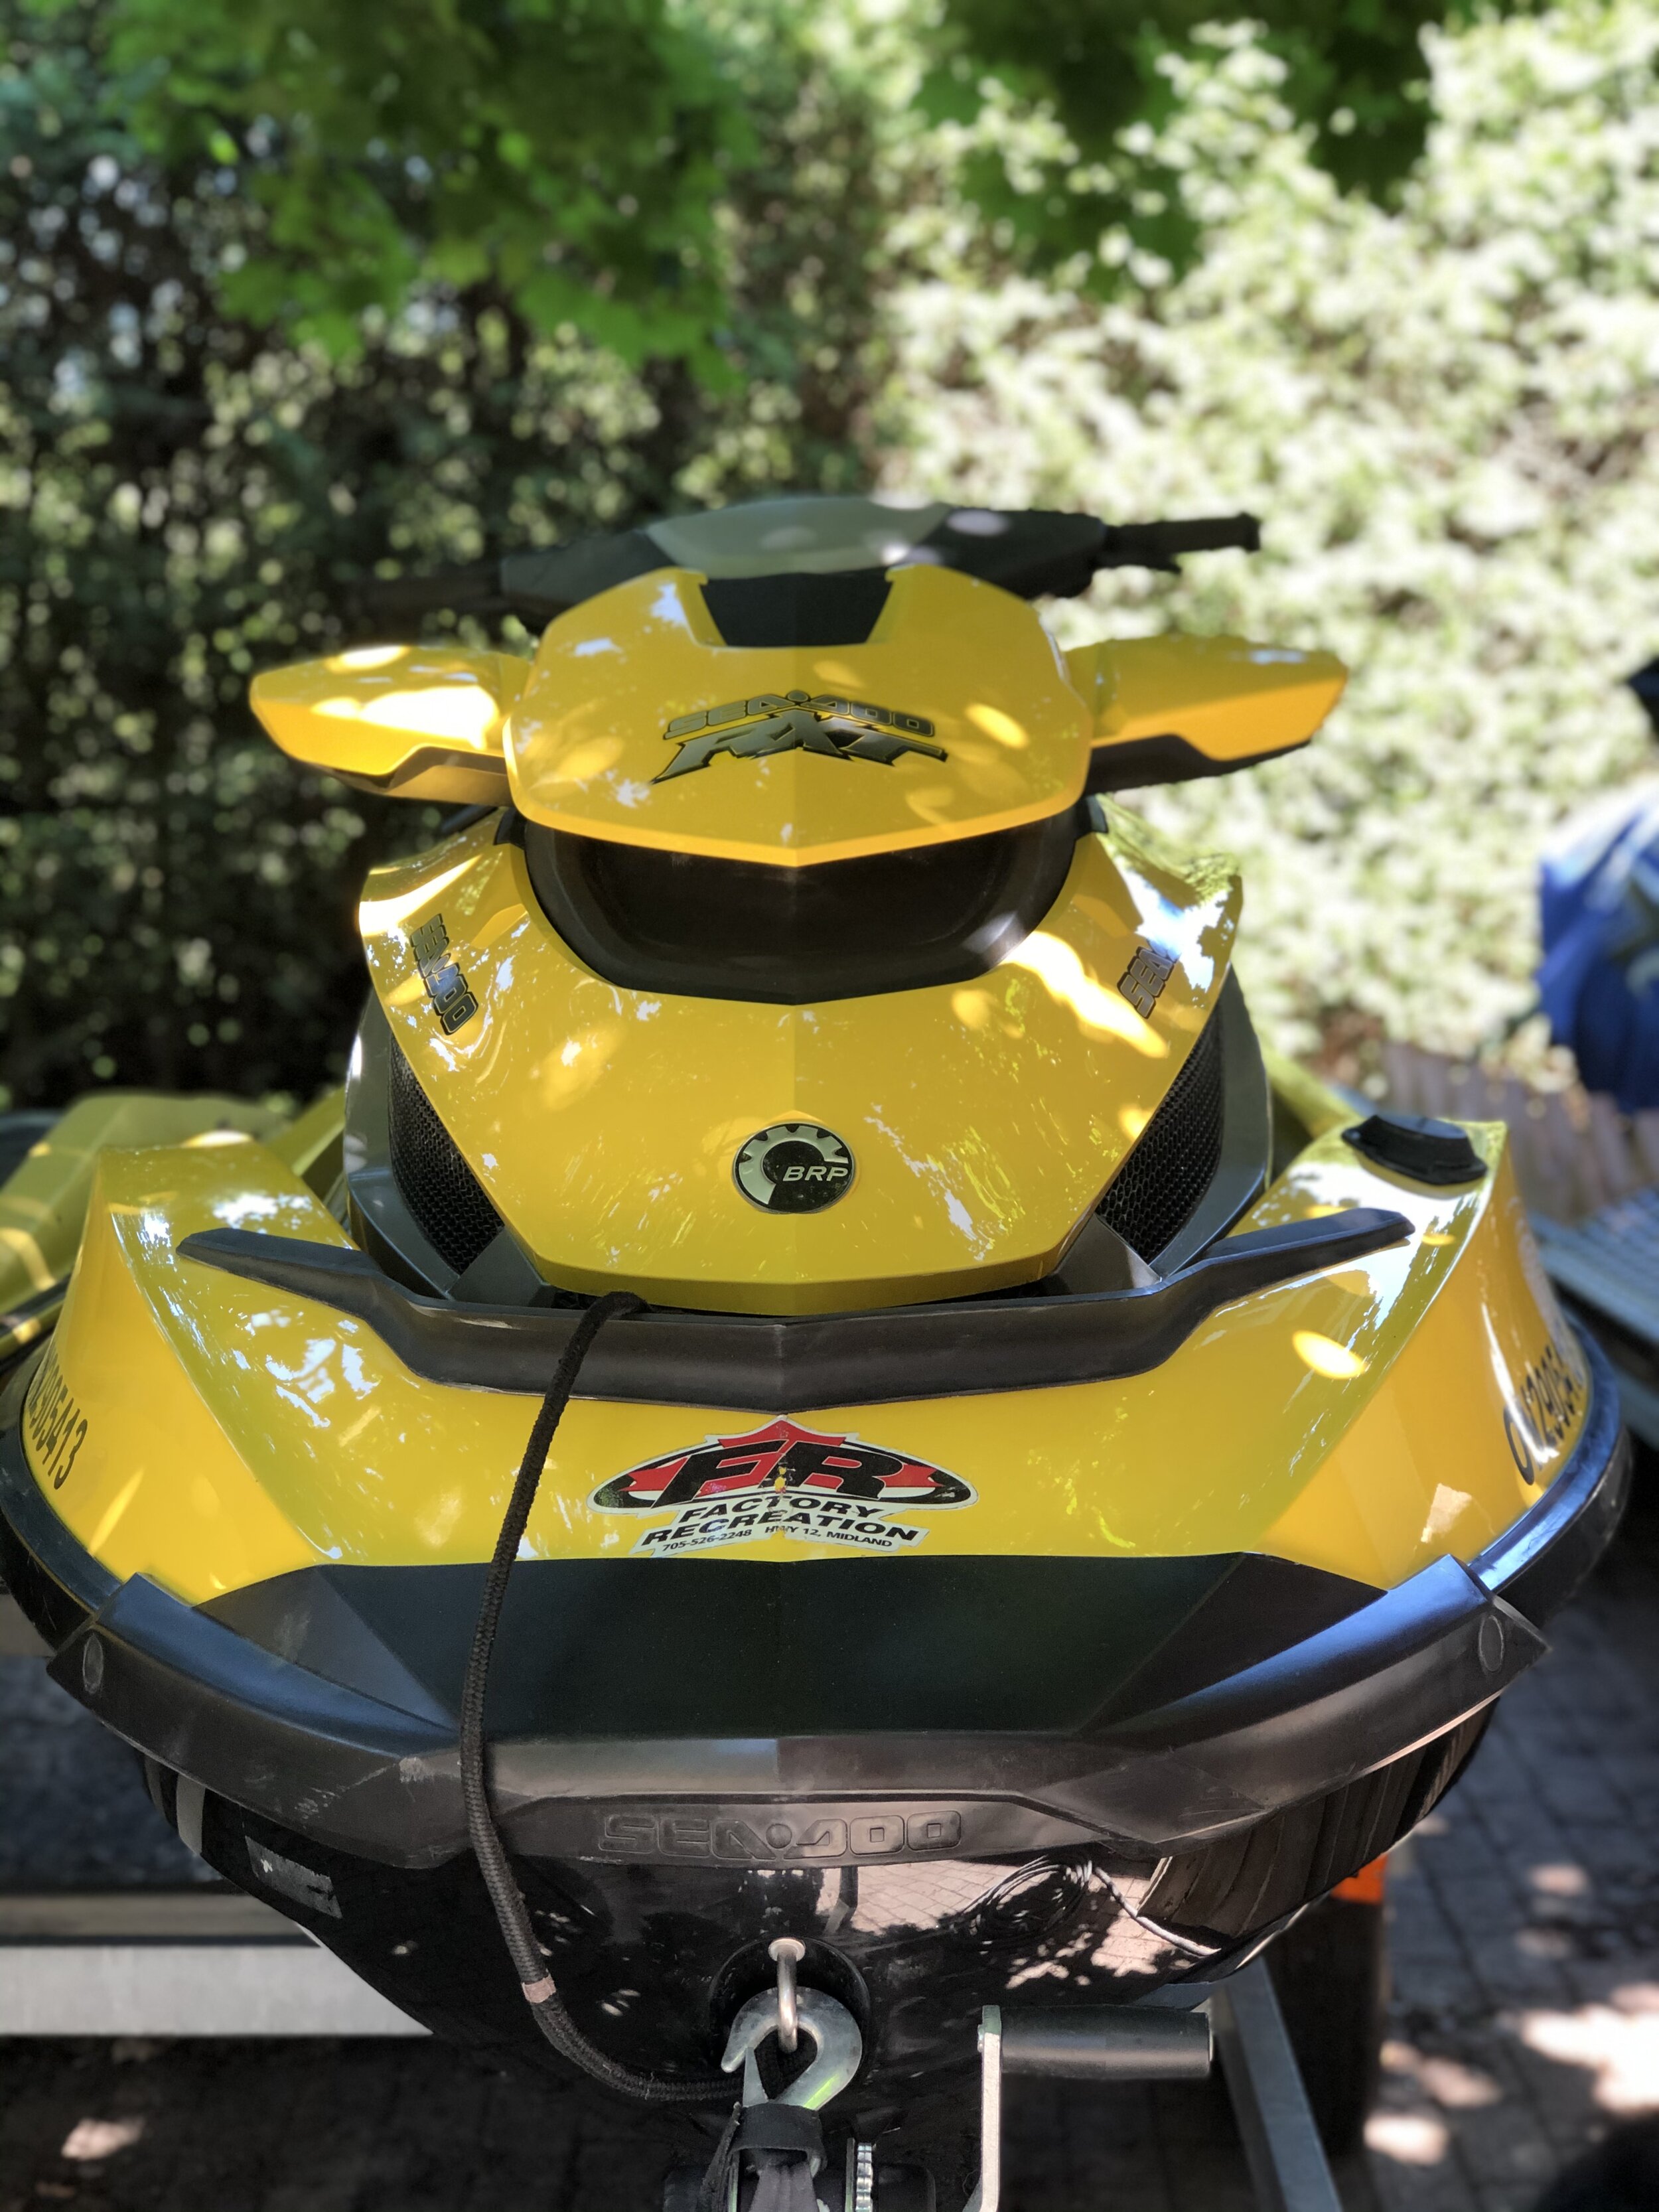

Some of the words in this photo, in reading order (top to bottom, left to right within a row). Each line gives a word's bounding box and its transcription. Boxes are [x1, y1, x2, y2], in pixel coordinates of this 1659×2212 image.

[782, 1165, 849, 1182] BRP
[678, 1495, 885, 1524] FACTORY
[641, 1509, 920, 1546] RECREATION
[662, 1529, 753, 1552] 705-526-2248
[803, 1527, 822, 1537] 12,
[826, 1530, 893, 1547] MIDLAND
